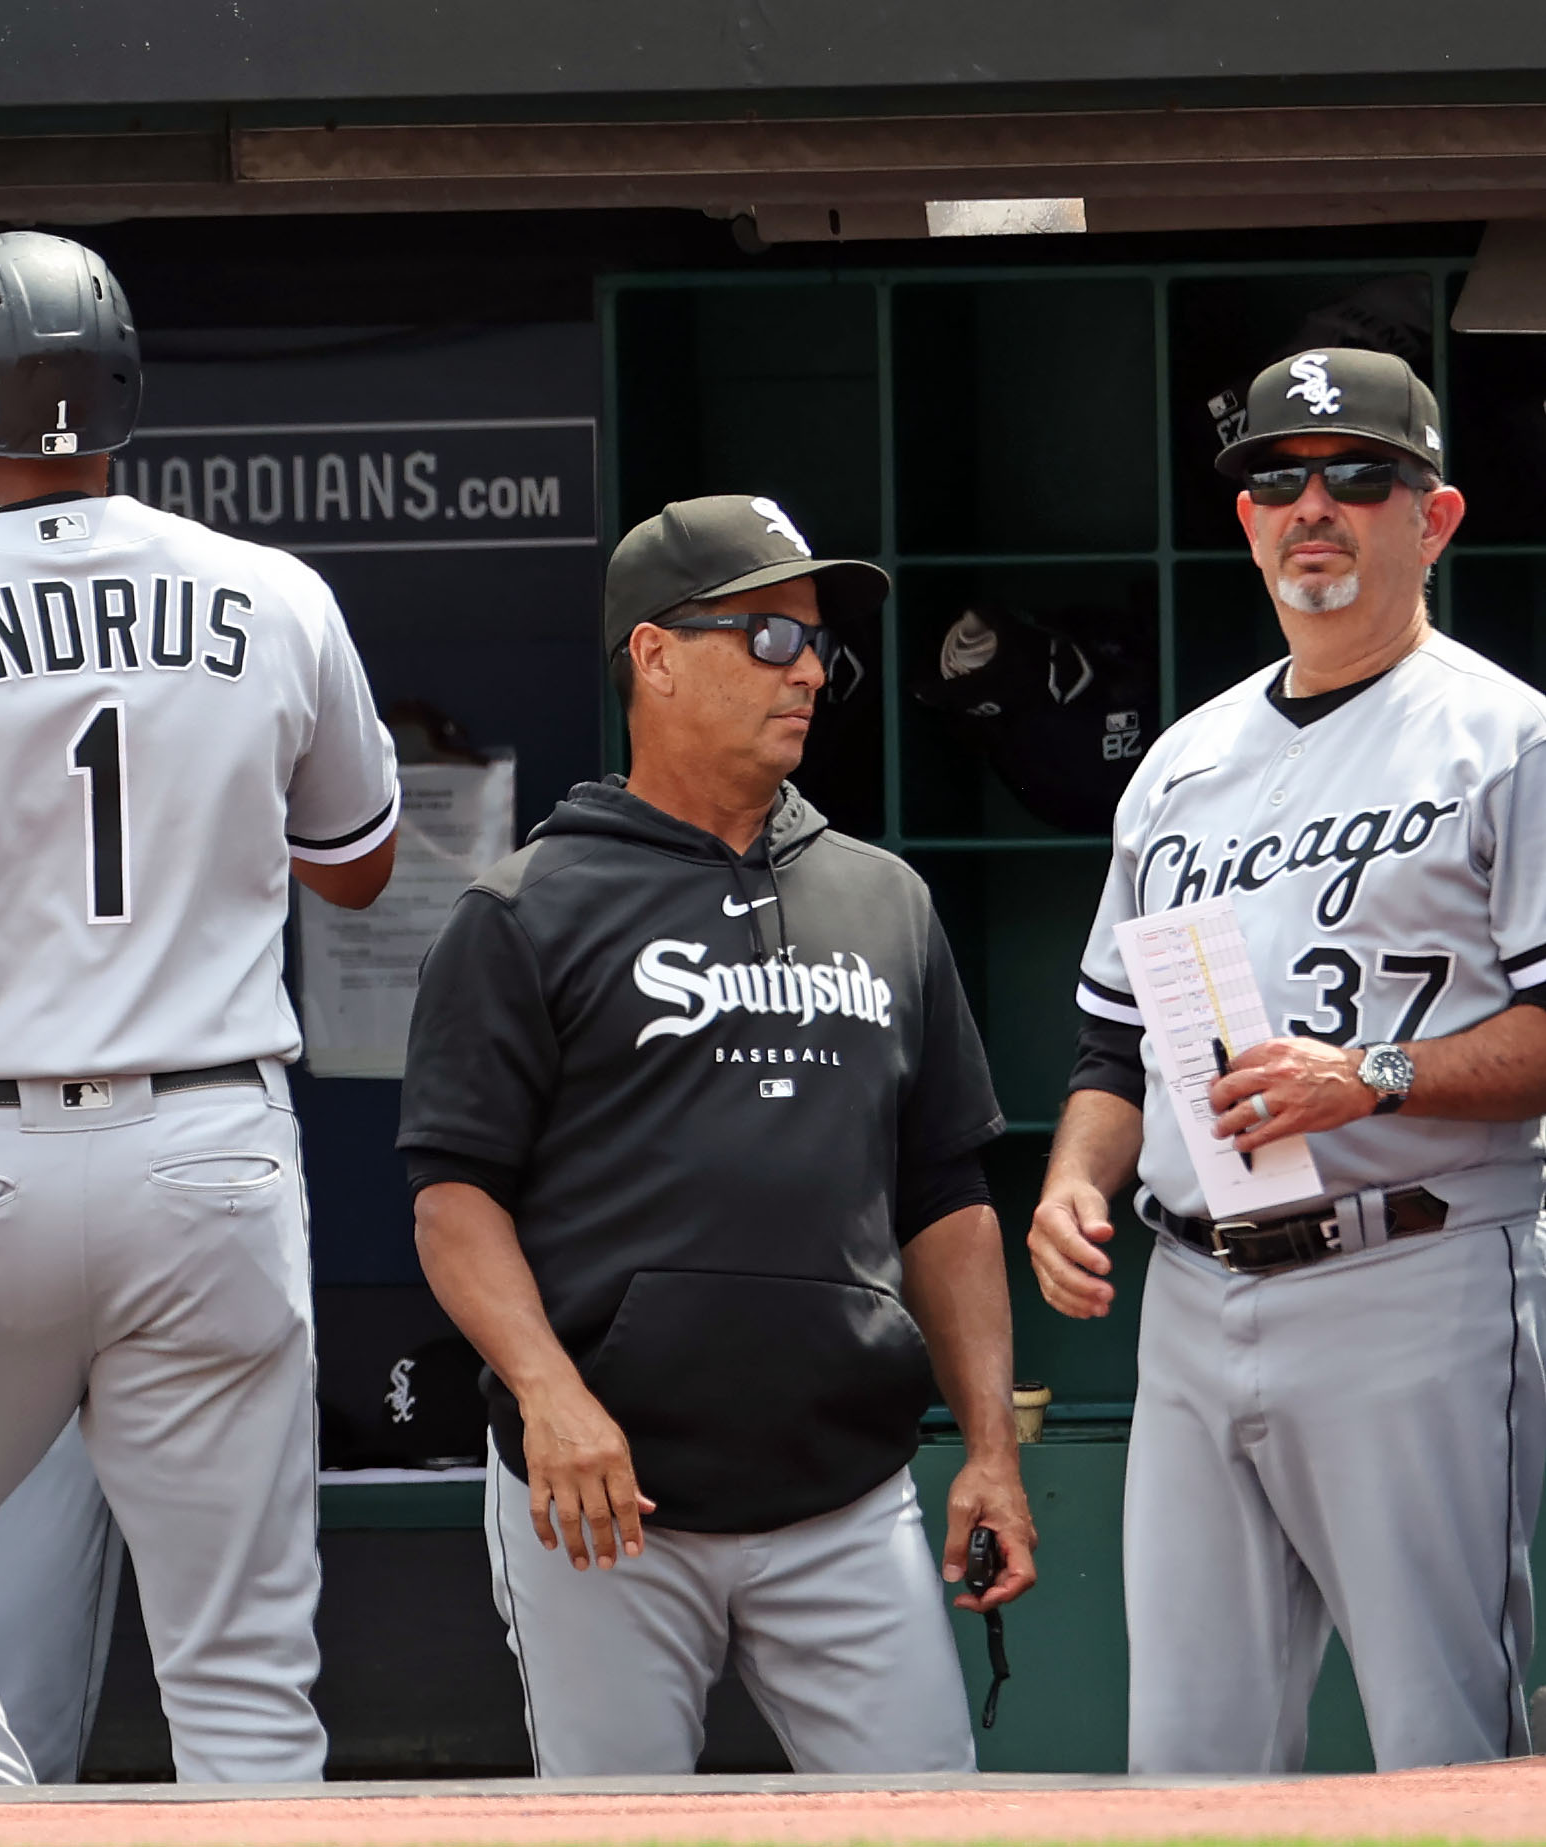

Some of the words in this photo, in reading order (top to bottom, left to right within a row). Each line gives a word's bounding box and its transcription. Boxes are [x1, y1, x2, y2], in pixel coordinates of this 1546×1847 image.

[56, 400, 67, 429] 1
[1286, 354, 1342, 415] Sox
[114, 450, 560, 524] UARDIANS.COM
[66, 700, 132, 924] 1
[1135, 797, 1462, 931] Chicago
[633, 938, 892, 1050] Southside
[1282, 943, 1455, 1047] 37
[714, 1047, 841, 1066] BASEBALL
